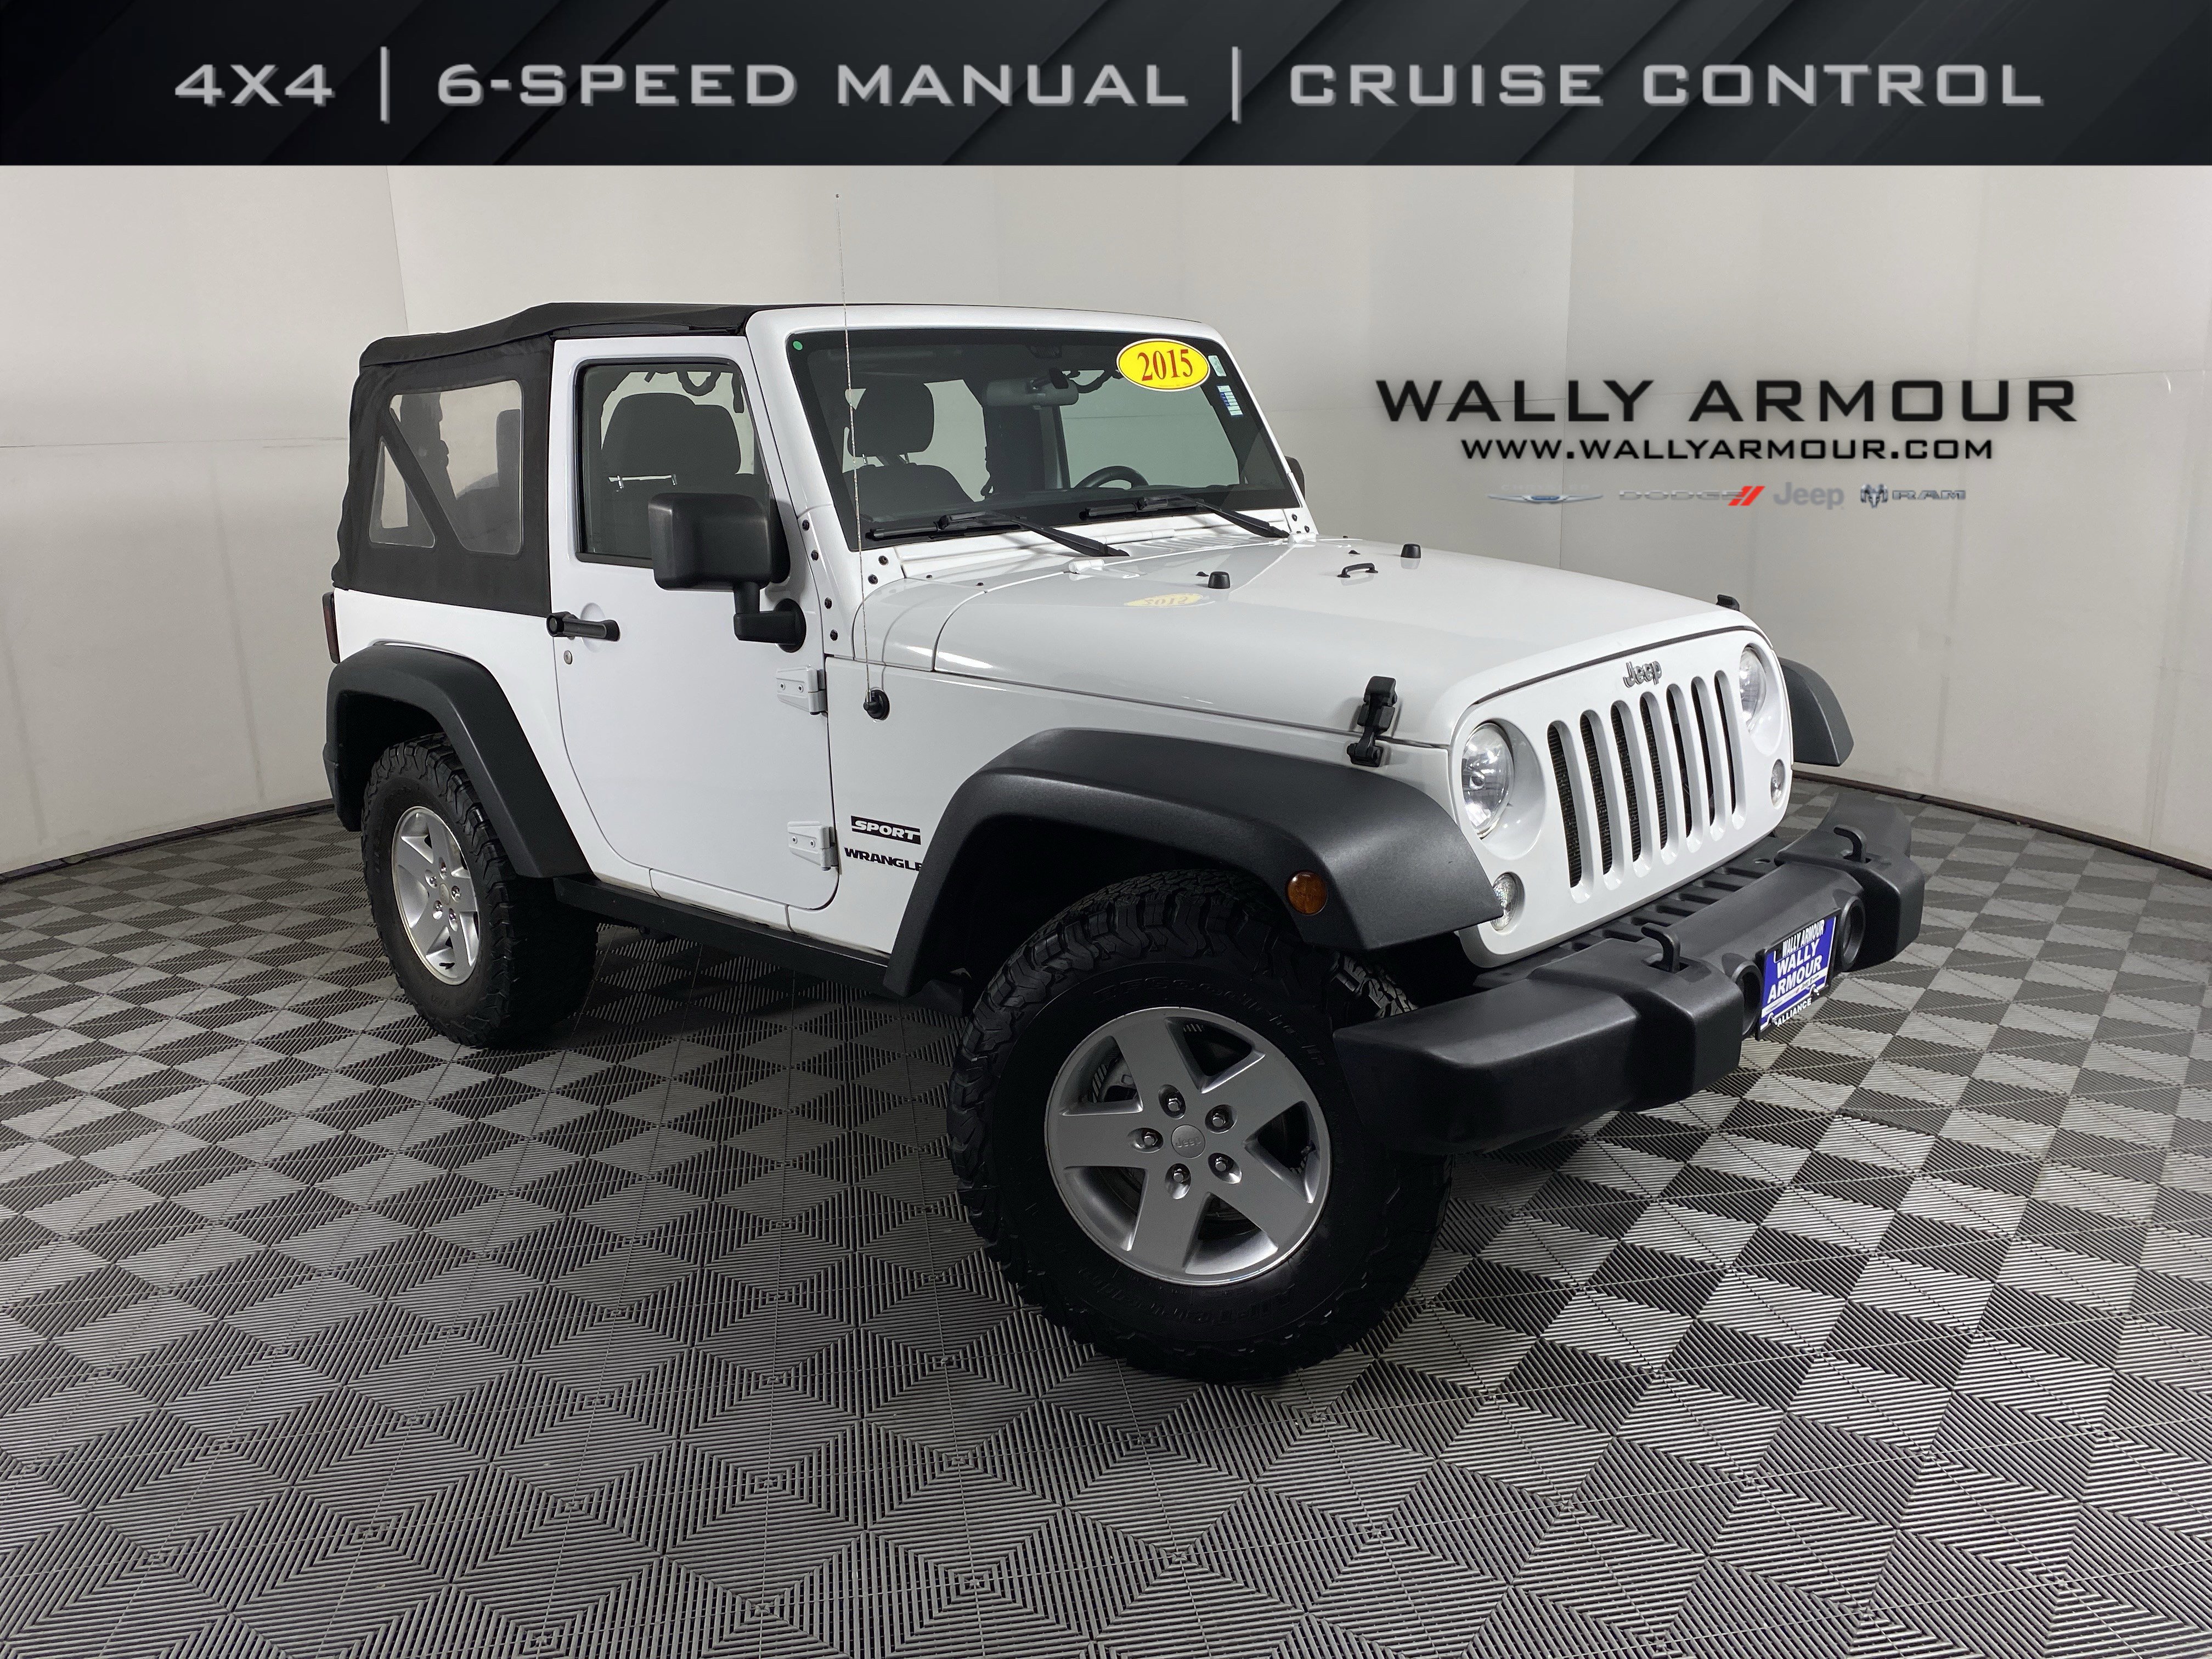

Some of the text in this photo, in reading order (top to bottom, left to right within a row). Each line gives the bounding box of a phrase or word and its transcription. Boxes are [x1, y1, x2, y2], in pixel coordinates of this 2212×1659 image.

[1137, 349, 1193, 381] 2015
[1622, 661, 1662, 688] Jeep
[855, 820, 921, 840] SPORT
[1782, 919, 1825, 957] WALLY ARMOUR
[1777, 939, 1820, 979] WALLY
[1767, 955, 1822, 1004] ARMOUR
[1777, 998, 1812, 1028] ALLIANCE
